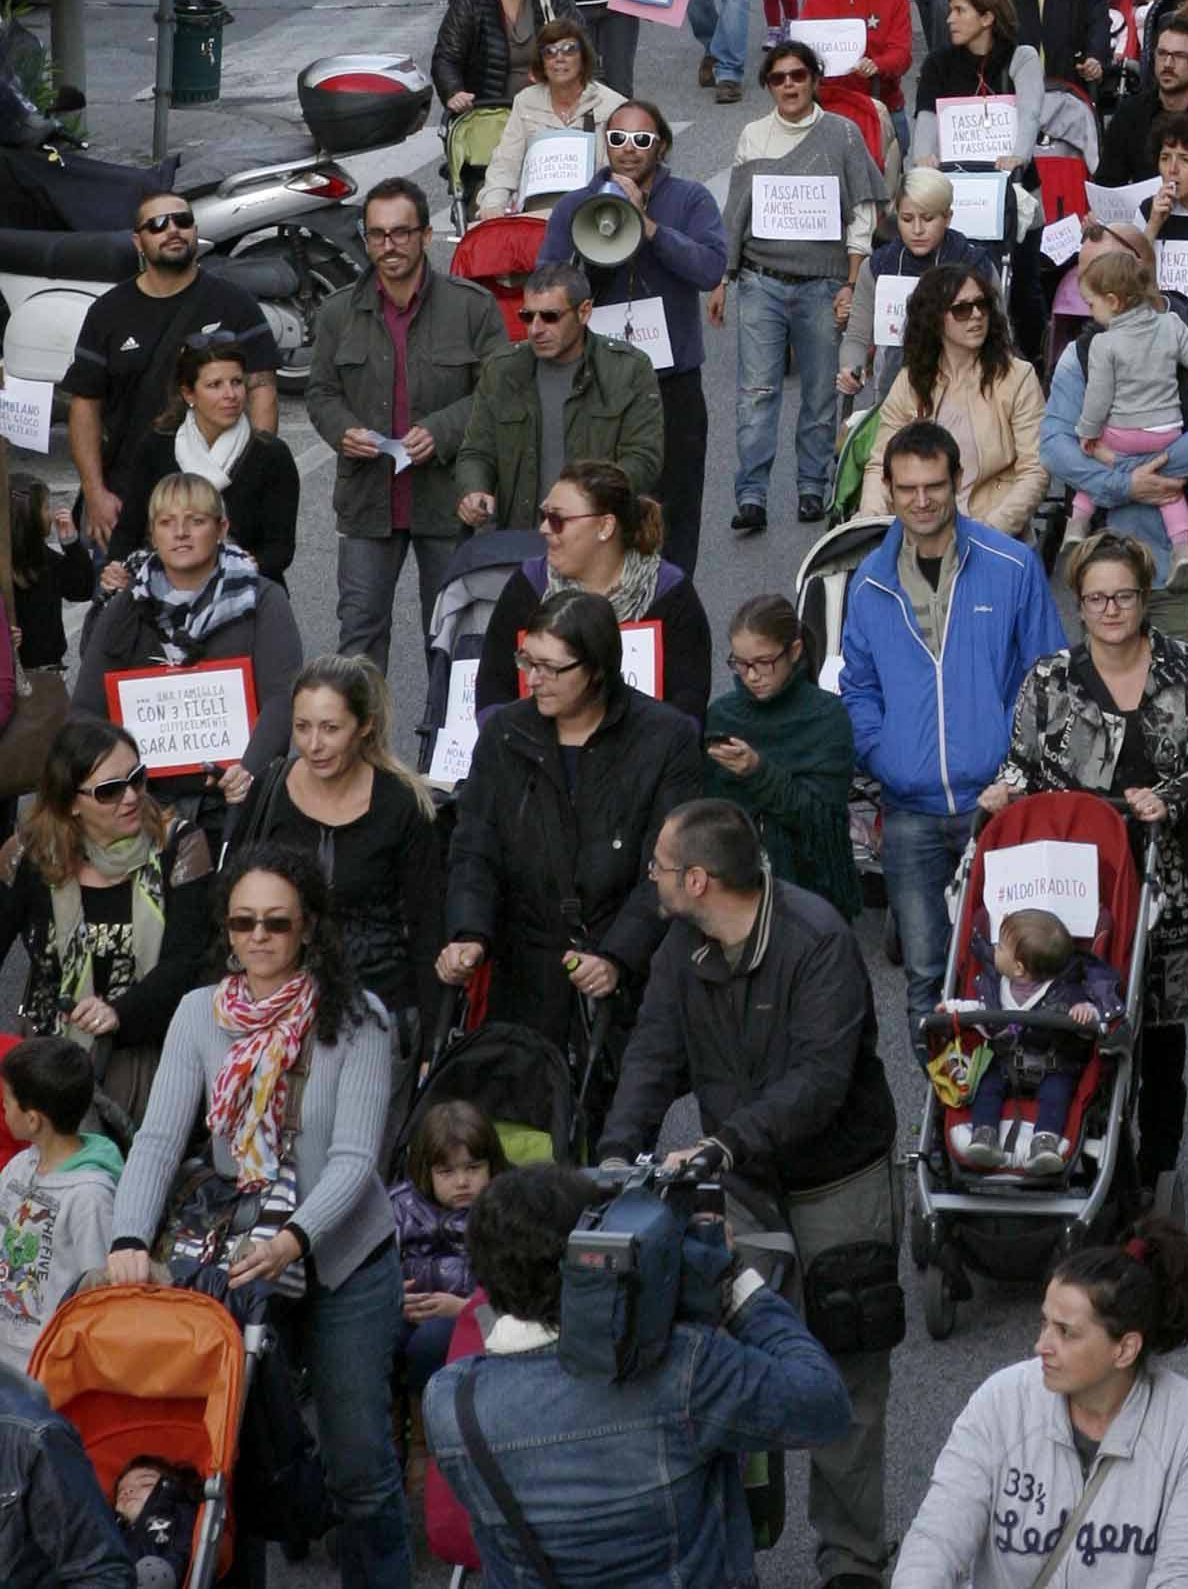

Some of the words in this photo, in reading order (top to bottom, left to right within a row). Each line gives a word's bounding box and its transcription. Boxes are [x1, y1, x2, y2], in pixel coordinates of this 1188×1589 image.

[762, 183, 827, 201] TASSATECI
[762, 201, 796, 215] ANCHE
[771, 216, 828, 230] PASSEGGINI
[136, 704, 166, 723] CON
[170, 705, 179, 719] 3
[184, 696, 229, 718] FIGLI
[139, 734, 178, 756] SARA
[183, 729, 231, 752] RICCA
[997, 876, 1088, 903] #NIDOTRADITO
